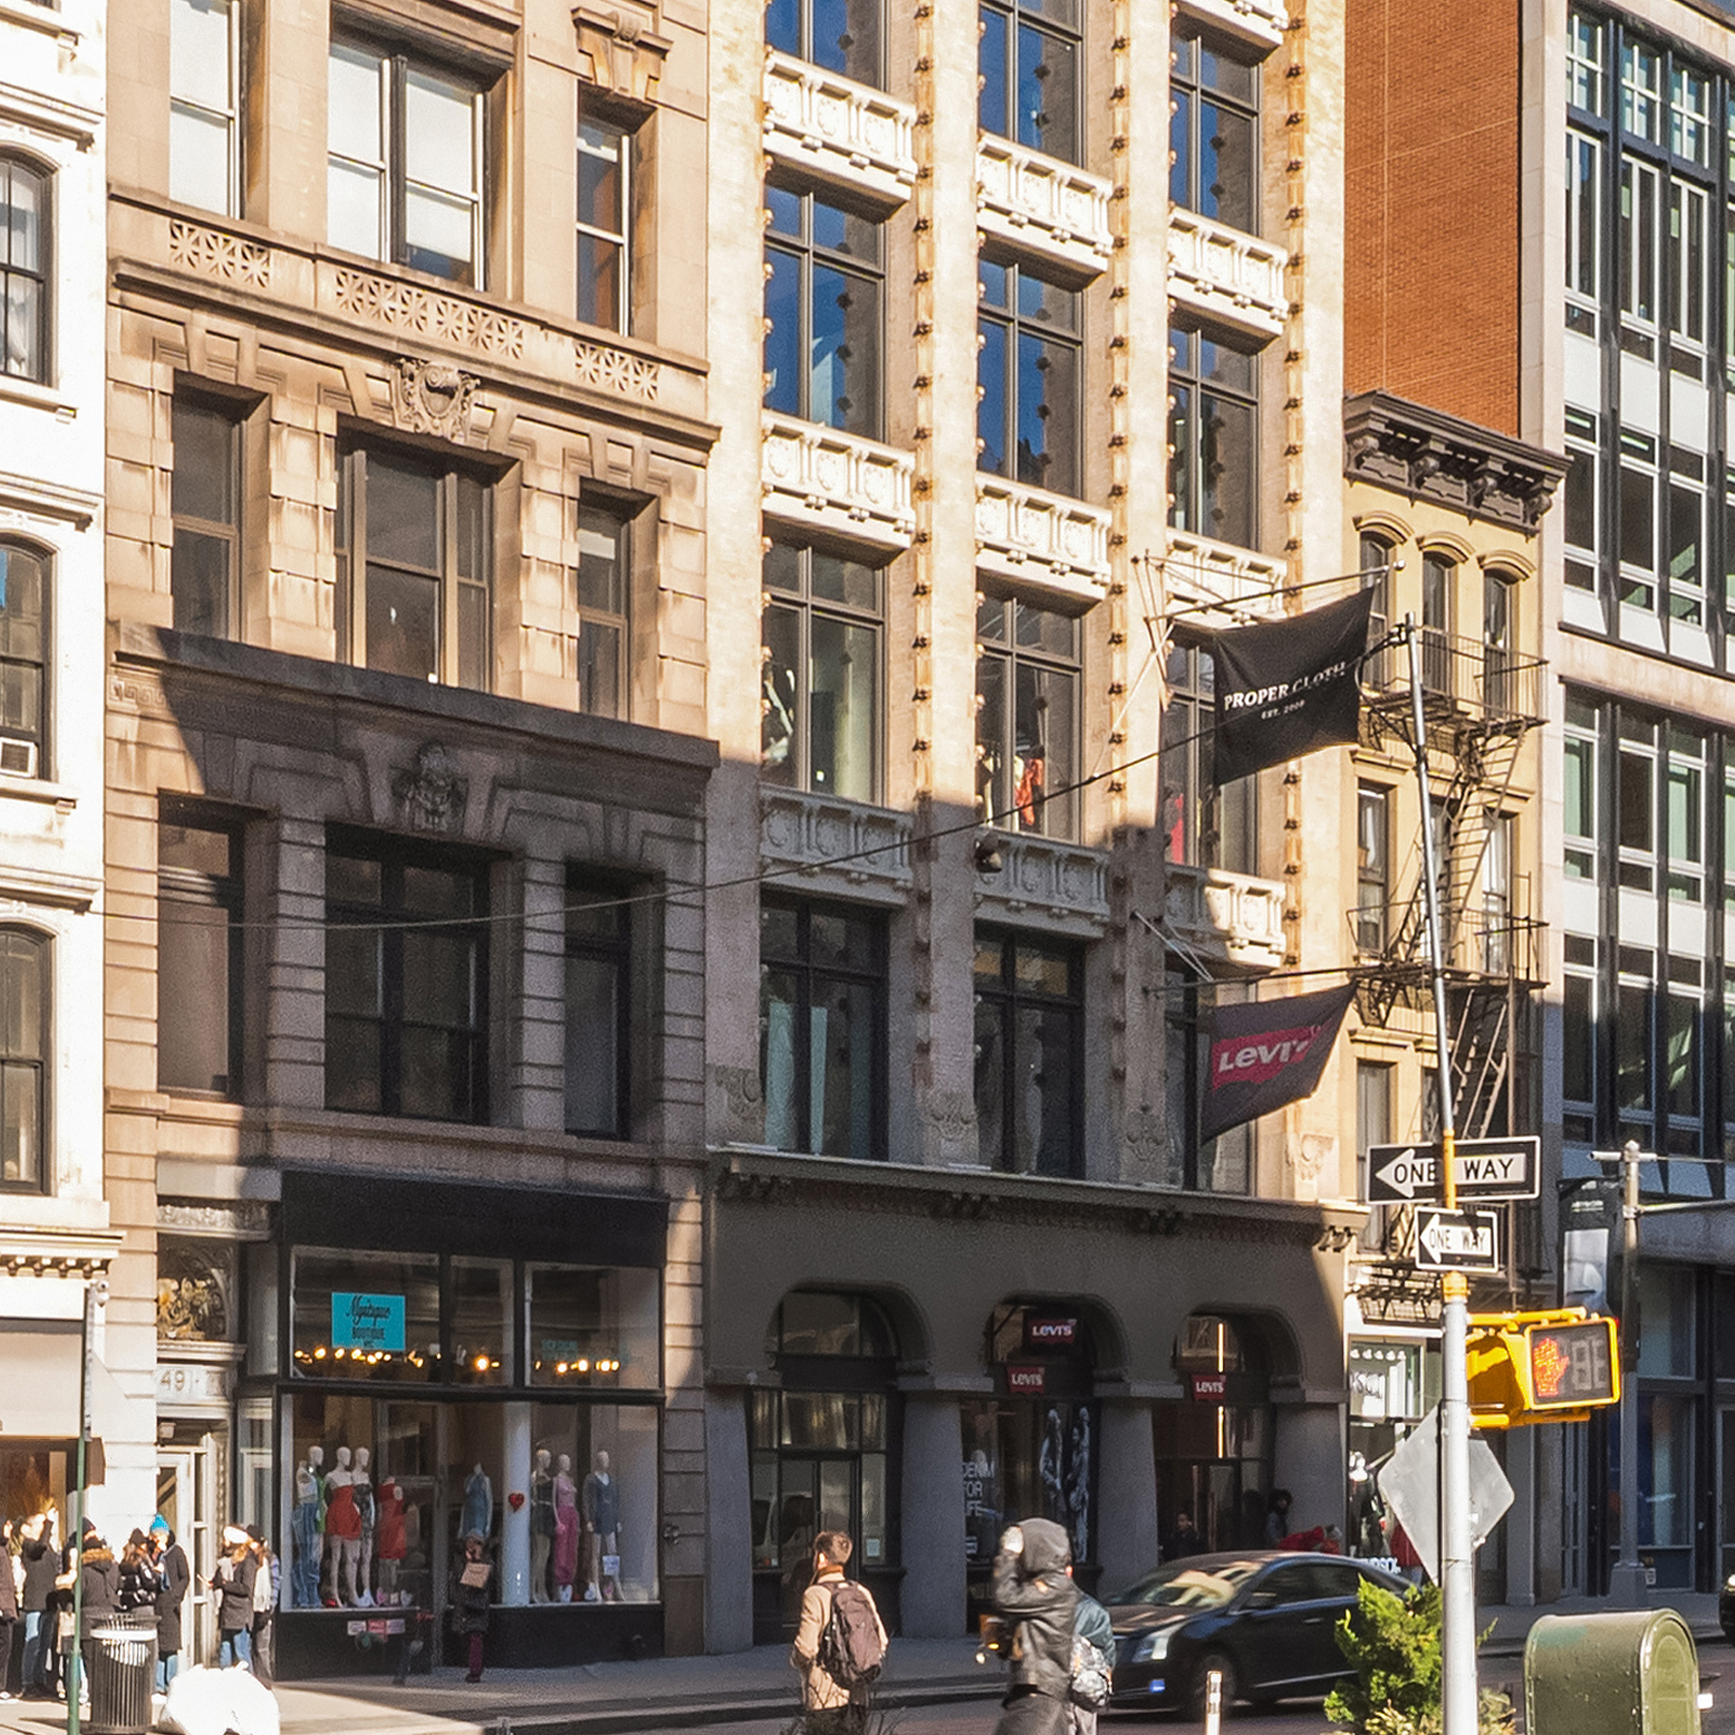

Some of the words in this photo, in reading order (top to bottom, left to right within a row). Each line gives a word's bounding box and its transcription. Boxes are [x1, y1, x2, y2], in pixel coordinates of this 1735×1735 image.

[1224, 683, 1290, 711] PROPER
[1394, 1161, 1437, 1184] ONE
[1464, 1158, 1514, 1181] WAY
[1430, 1228, 1452, 1251] ONE
